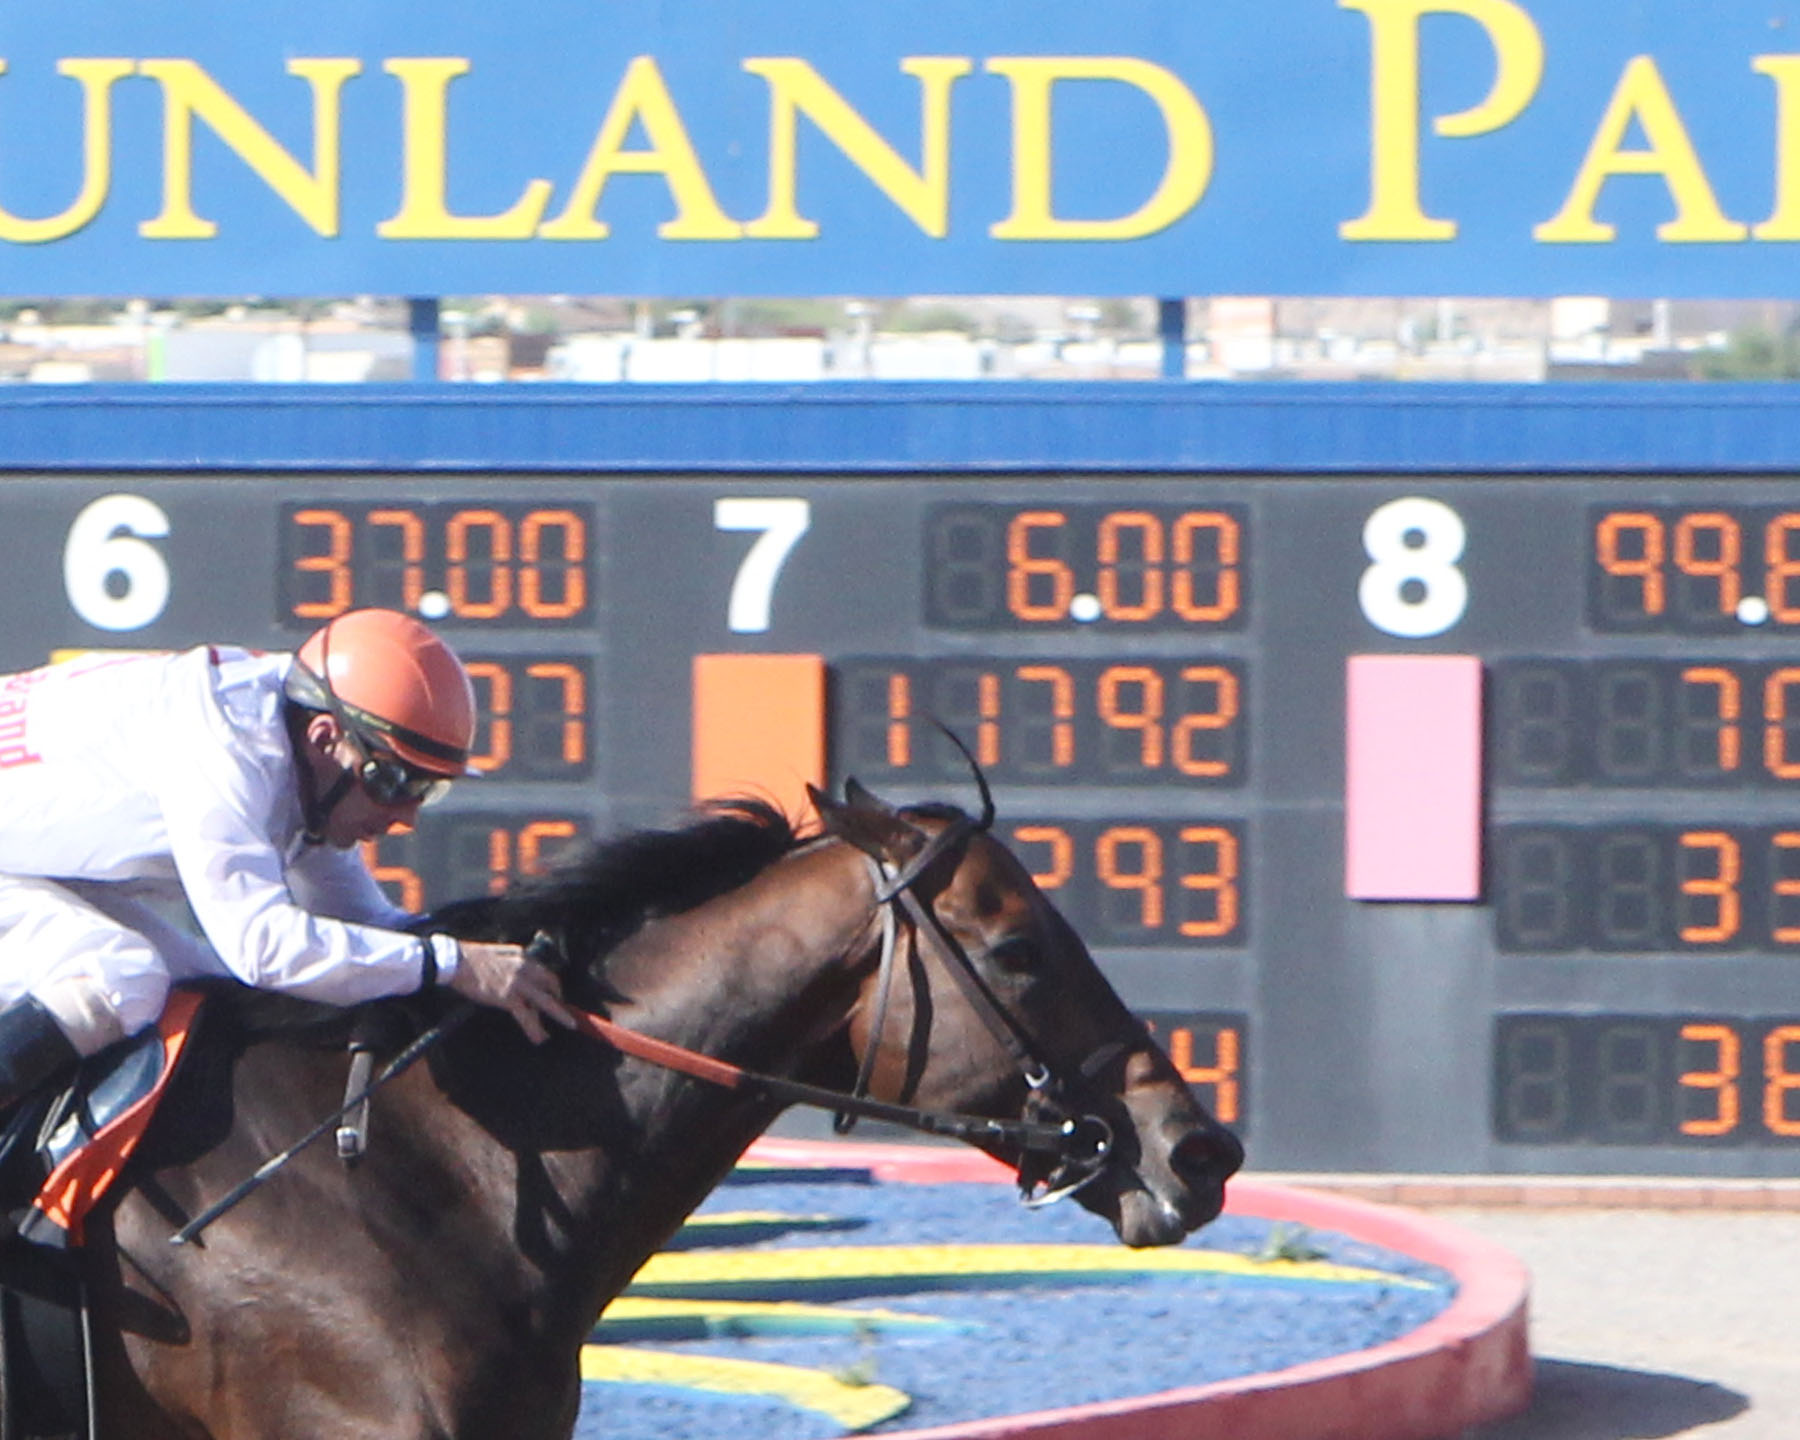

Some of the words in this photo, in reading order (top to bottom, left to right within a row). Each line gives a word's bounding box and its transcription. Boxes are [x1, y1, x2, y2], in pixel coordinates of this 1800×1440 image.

[64, 494, 170, 631] 6
[293, 510, 586, 619] 37.00
[715, 498, 810, 632] 7
[1007, 511, 1239, 622] 6.00
[1359, 497, 1468, 638] 8
